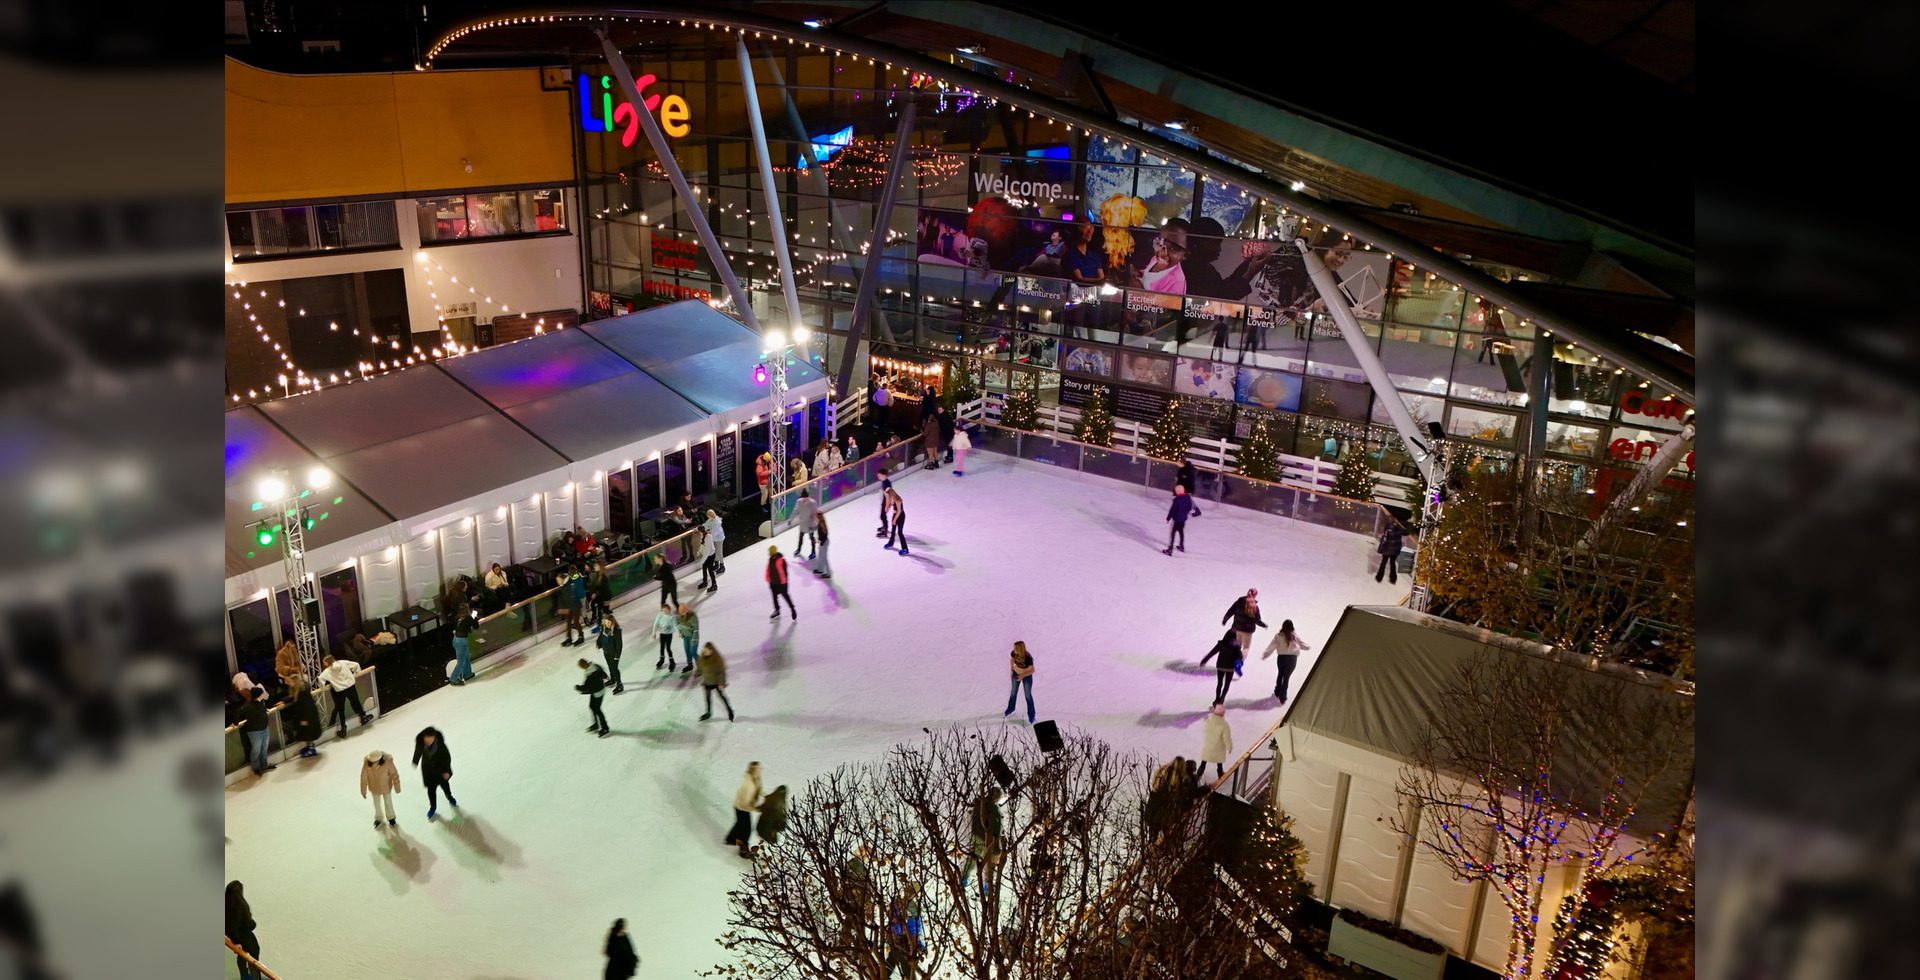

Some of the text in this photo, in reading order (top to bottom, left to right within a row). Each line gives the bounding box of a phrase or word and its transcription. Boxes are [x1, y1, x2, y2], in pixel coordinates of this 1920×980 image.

[578, 73, 691, 147] Life
[974, 171, 1080, 201] Welcome...
[1127, 293, 1156, 305] Excited
[1127, 302, 1165, 314] Explorers
[1184, 309, 1216, 321] Solvers
[1247, 317, 1276, 329] Lovers
[1063, 379, 1083, 391] Story
